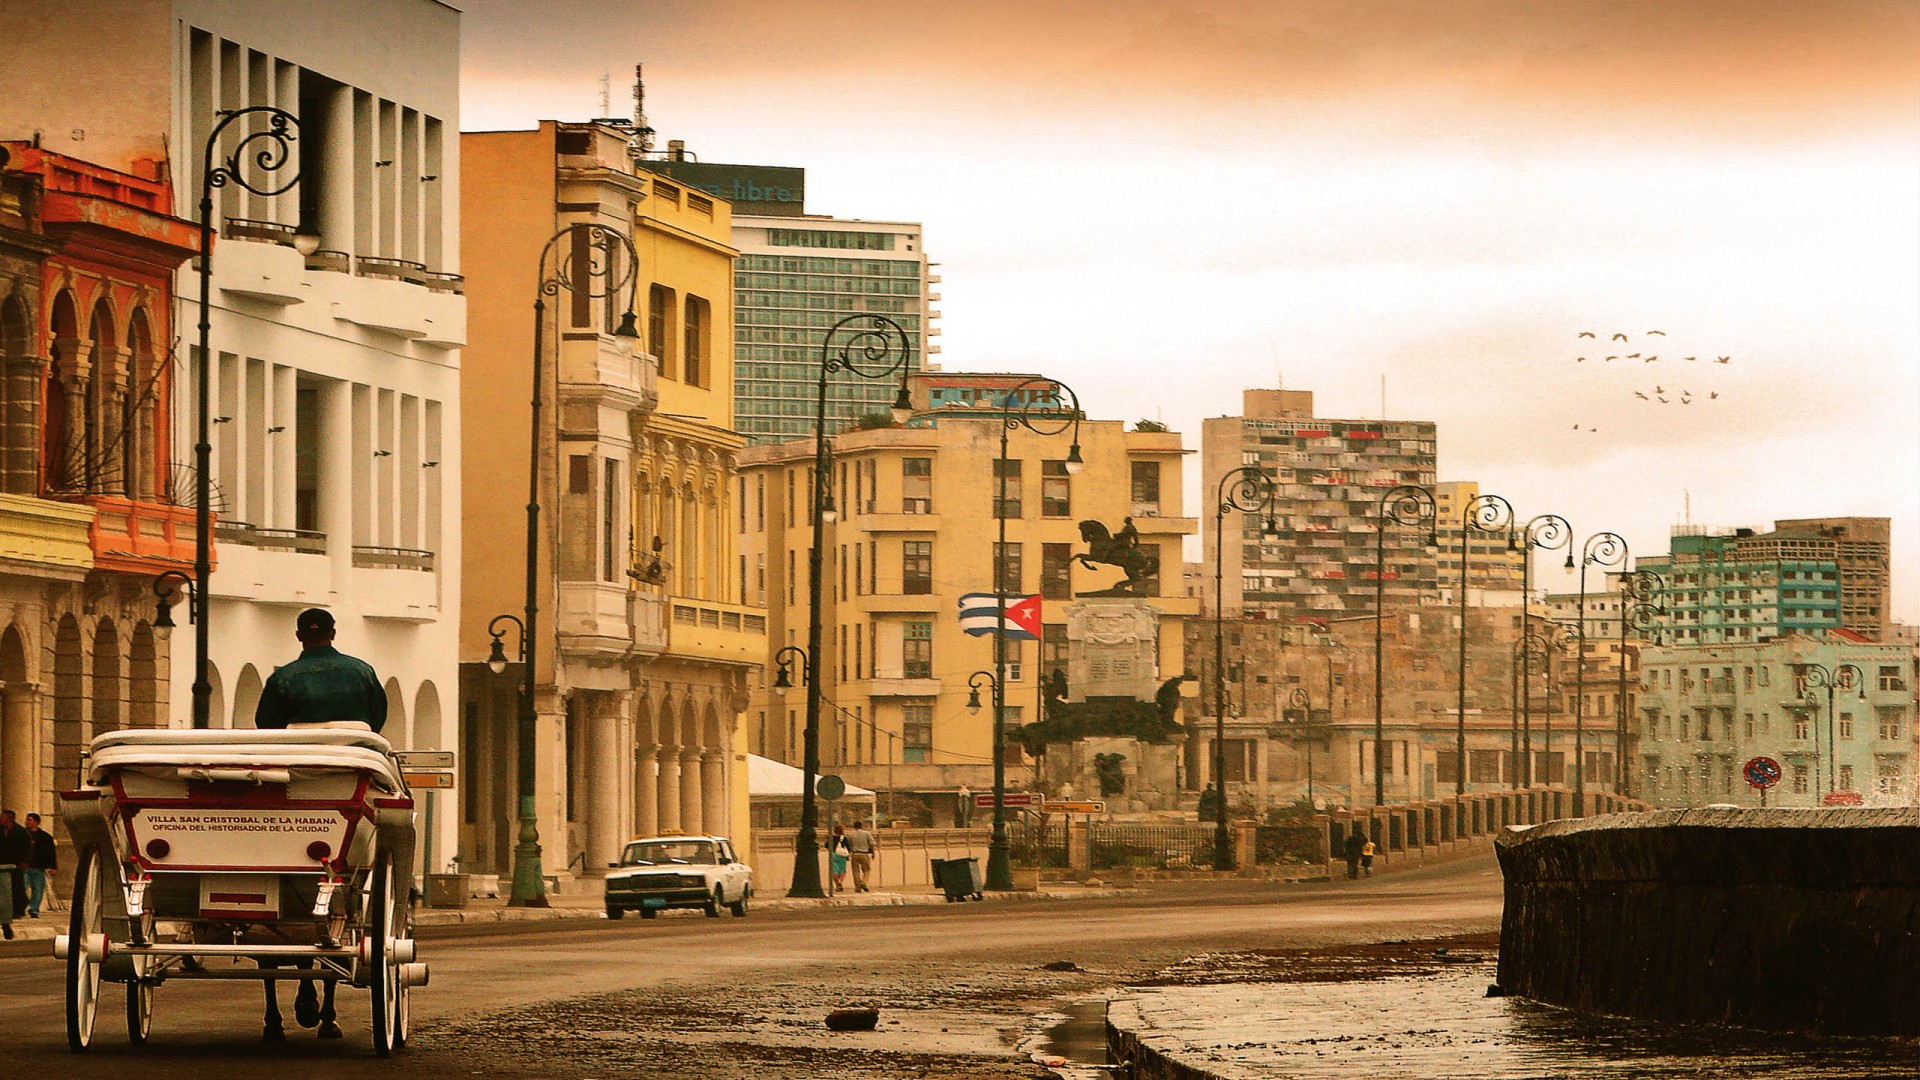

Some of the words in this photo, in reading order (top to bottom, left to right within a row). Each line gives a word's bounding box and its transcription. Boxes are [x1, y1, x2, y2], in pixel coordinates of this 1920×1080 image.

[733, 179, 792, 202] libre
[147, 815, 176, 823] VILLA
[203, 816, 260, 824] CRISTOBAL
